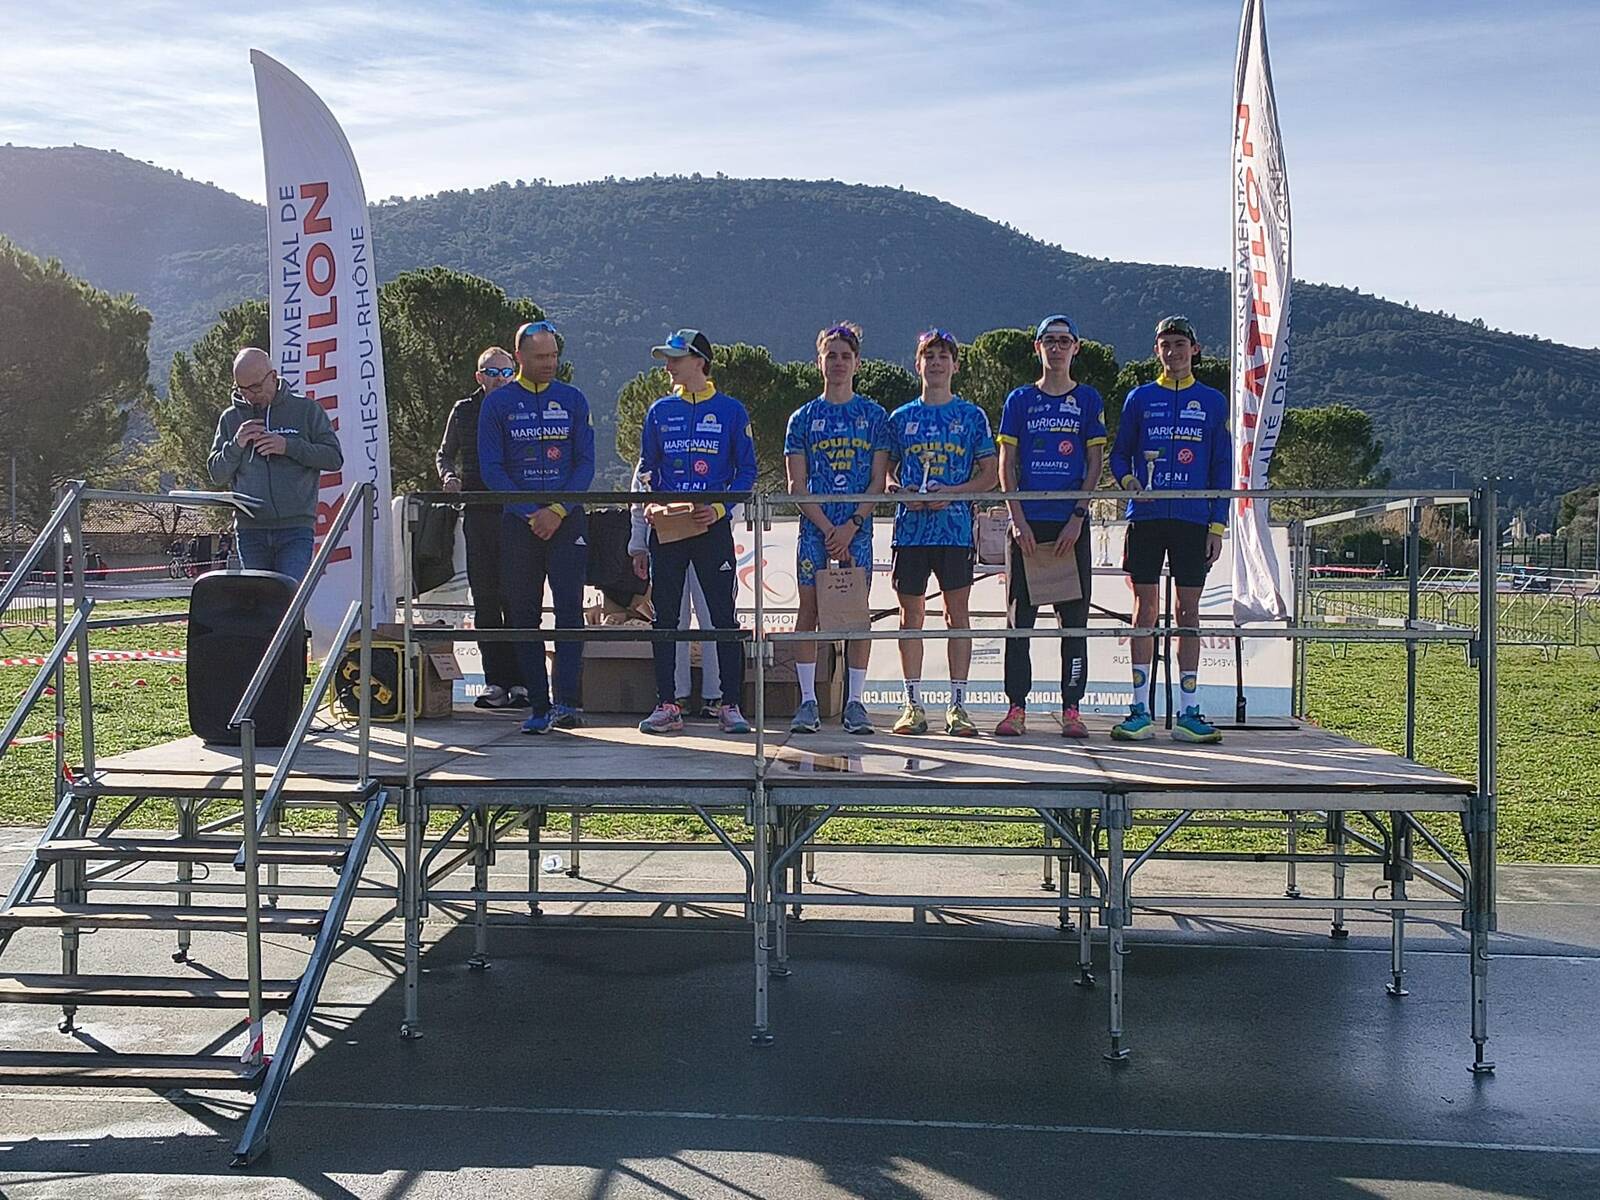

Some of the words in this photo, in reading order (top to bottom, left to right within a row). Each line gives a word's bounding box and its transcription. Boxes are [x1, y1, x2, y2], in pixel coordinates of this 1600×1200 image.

[279, 185, 296, 222] DE
[280, 233, 301, 394] RTEMENTAL
[511, 426, 569, 438] MARIGNANE
[664, 439, 720, 450] MARIGNANE
[812, 437, 872, 454] TOULON
[904, 442, 966, 456] TOULON
[826, 449, 855, 459] VAR
[830, 461, 851, 470] TRI
